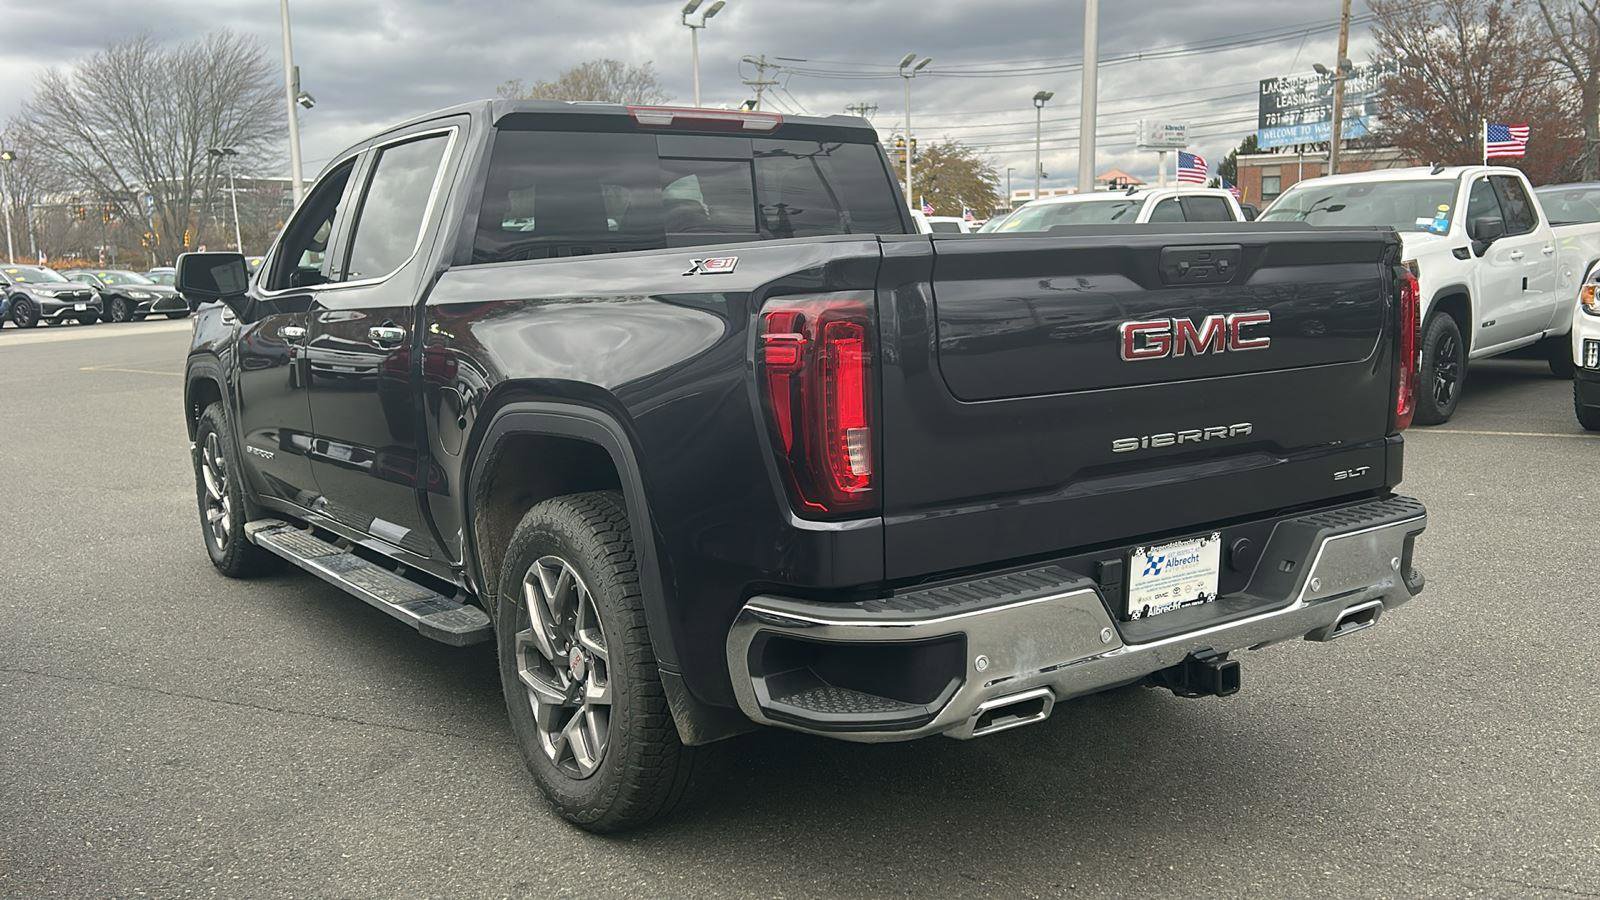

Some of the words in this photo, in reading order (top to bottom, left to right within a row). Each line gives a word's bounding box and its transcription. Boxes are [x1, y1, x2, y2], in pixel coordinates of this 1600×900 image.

[1276, 92, 1315, 108] LEASING
[1263, 127, 1297, 140] WELCOME
[1300, 125, 1310, 134] TO
[681, 256, 739, 277] X31
[1119, 309, 1271, 362] GMC
[1111, 422, 1253, 453] SIERRA
[1333, 466, 1371, 481] SLT
[1166, 554, 1199, 568] Albrecht
[1147, 601, 1181, 617] Albrecht
